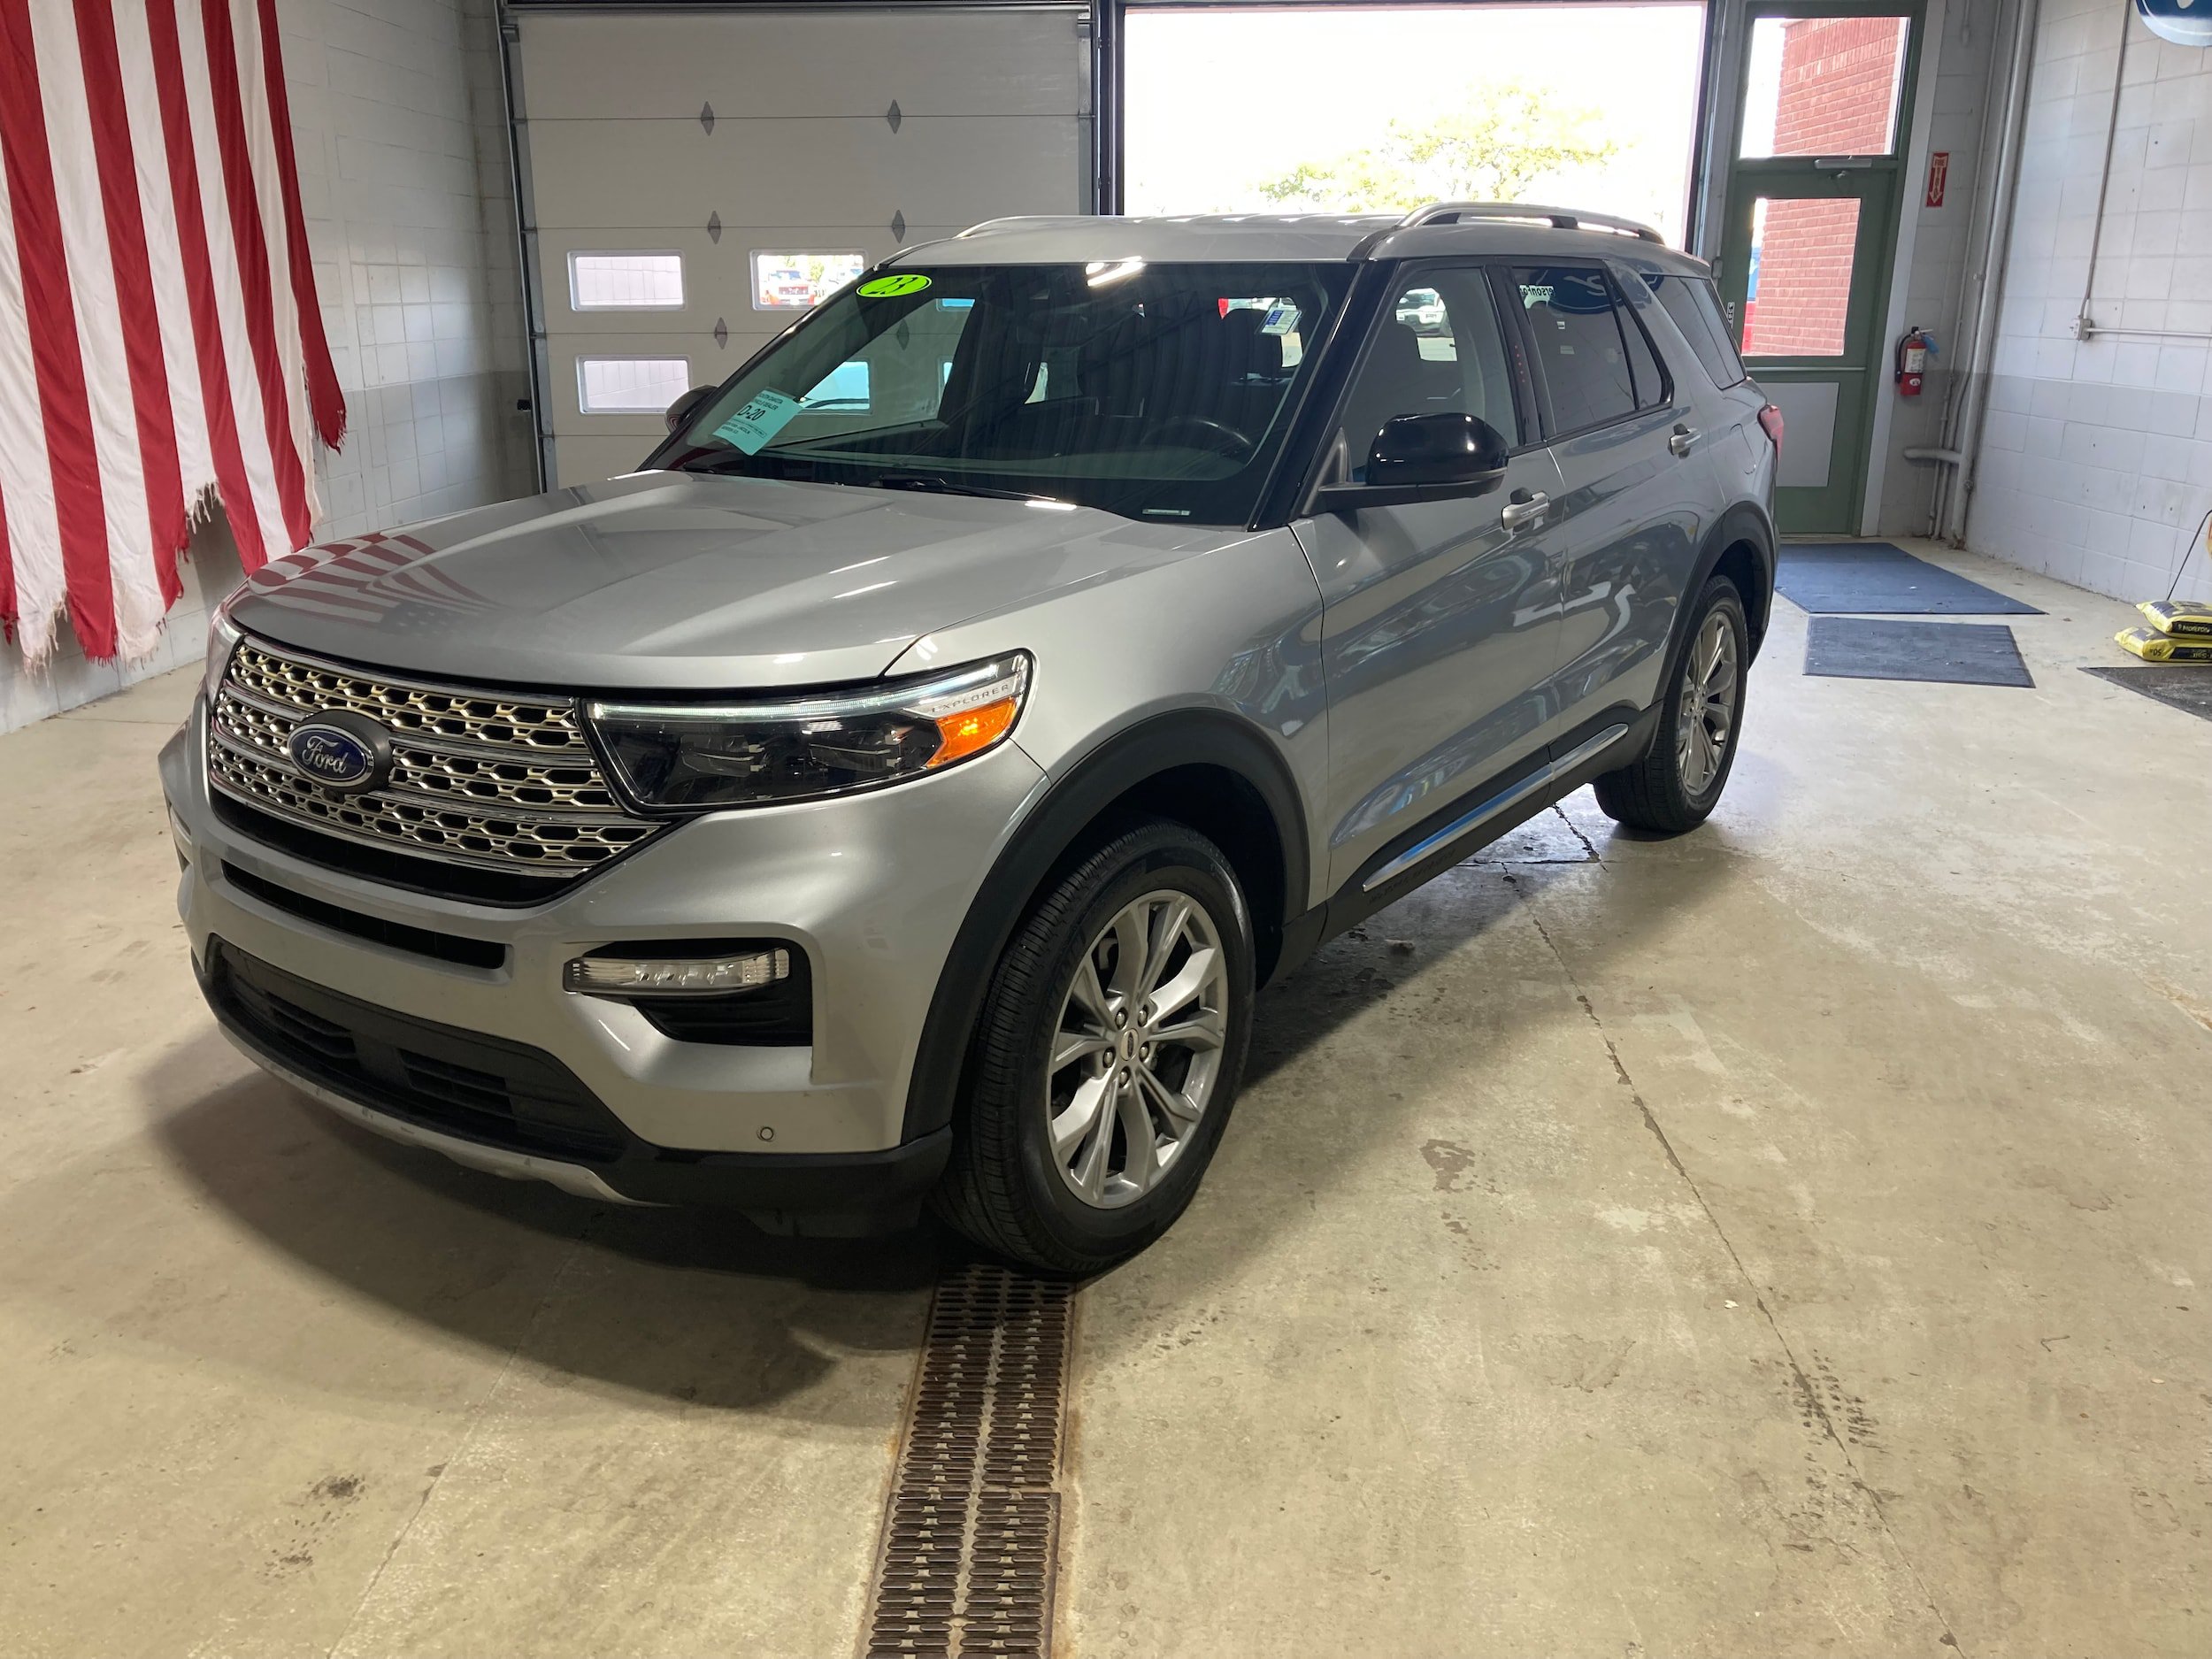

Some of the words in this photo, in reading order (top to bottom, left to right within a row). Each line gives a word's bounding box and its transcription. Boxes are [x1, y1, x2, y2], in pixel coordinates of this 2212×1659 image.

[867, 277, 918, 295] 23
[736, 404, 766, 421] D-20
[932, 684, 1009, 712] EXPLORER
[302, 735, 349, 774] Ford
